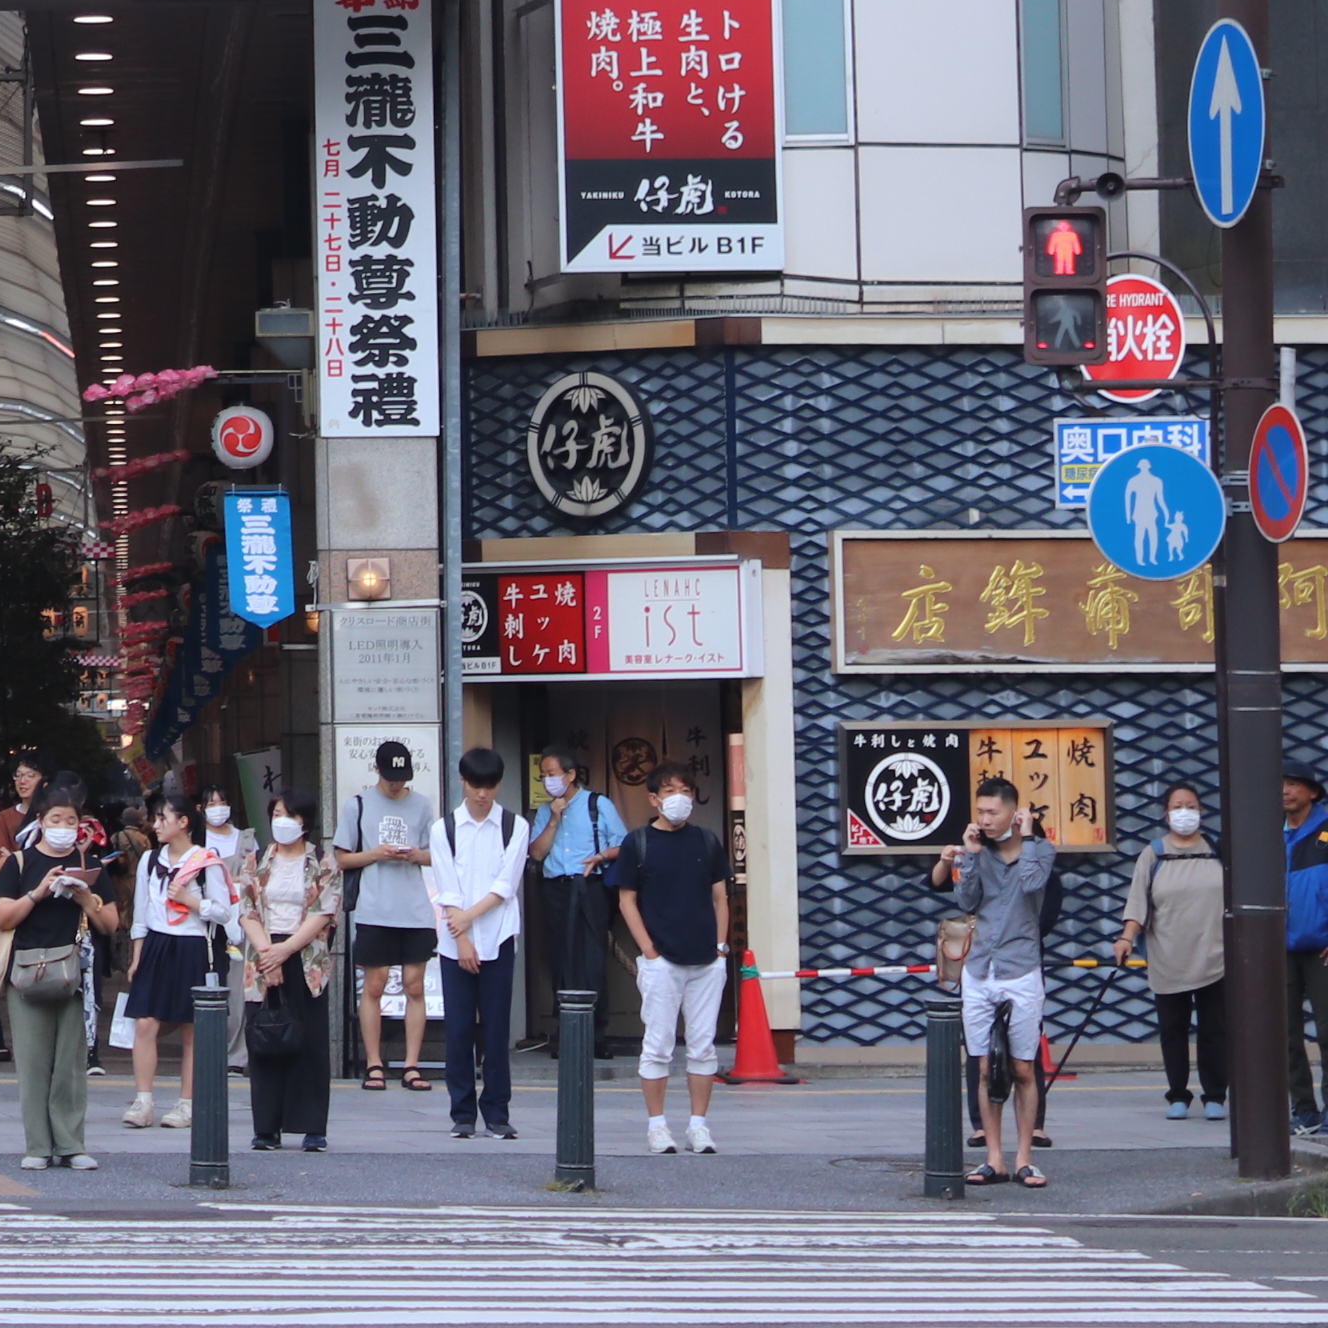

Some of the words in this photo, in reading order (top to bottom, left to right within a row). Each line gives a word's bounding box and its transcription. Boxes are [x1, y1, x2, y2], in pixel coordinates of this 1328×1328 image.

[627, 9, 665, 154] 極上和牛
[716, 9, 747, 150] トロける
[580, 191, 625, 200] YAKINIKU
[634, 173, 715, 216] 仔虎
[724, 190, 761, 199] KOTORA
[641, 235, 709, 257] 当ビル
[716, 236, 765, 255] B1F
[1119, 292, 1165, 308] HYDRANT
[540, 413, 631, 470] 仔虎
[643, 578, 702, 598] LENAHC
[339, 615, 432, 628] クリスロード商店街
[529, 583, 551, 666] ユッケ
[554, 581, 577, 666] 焼肉
[348, 639, 423, 651] LED照明導入
[358, 652, 411, 665] 2011年1月
[1066, 736, 1098, 825] 焼肉
[873, 777, 942, 814] 仔虎
